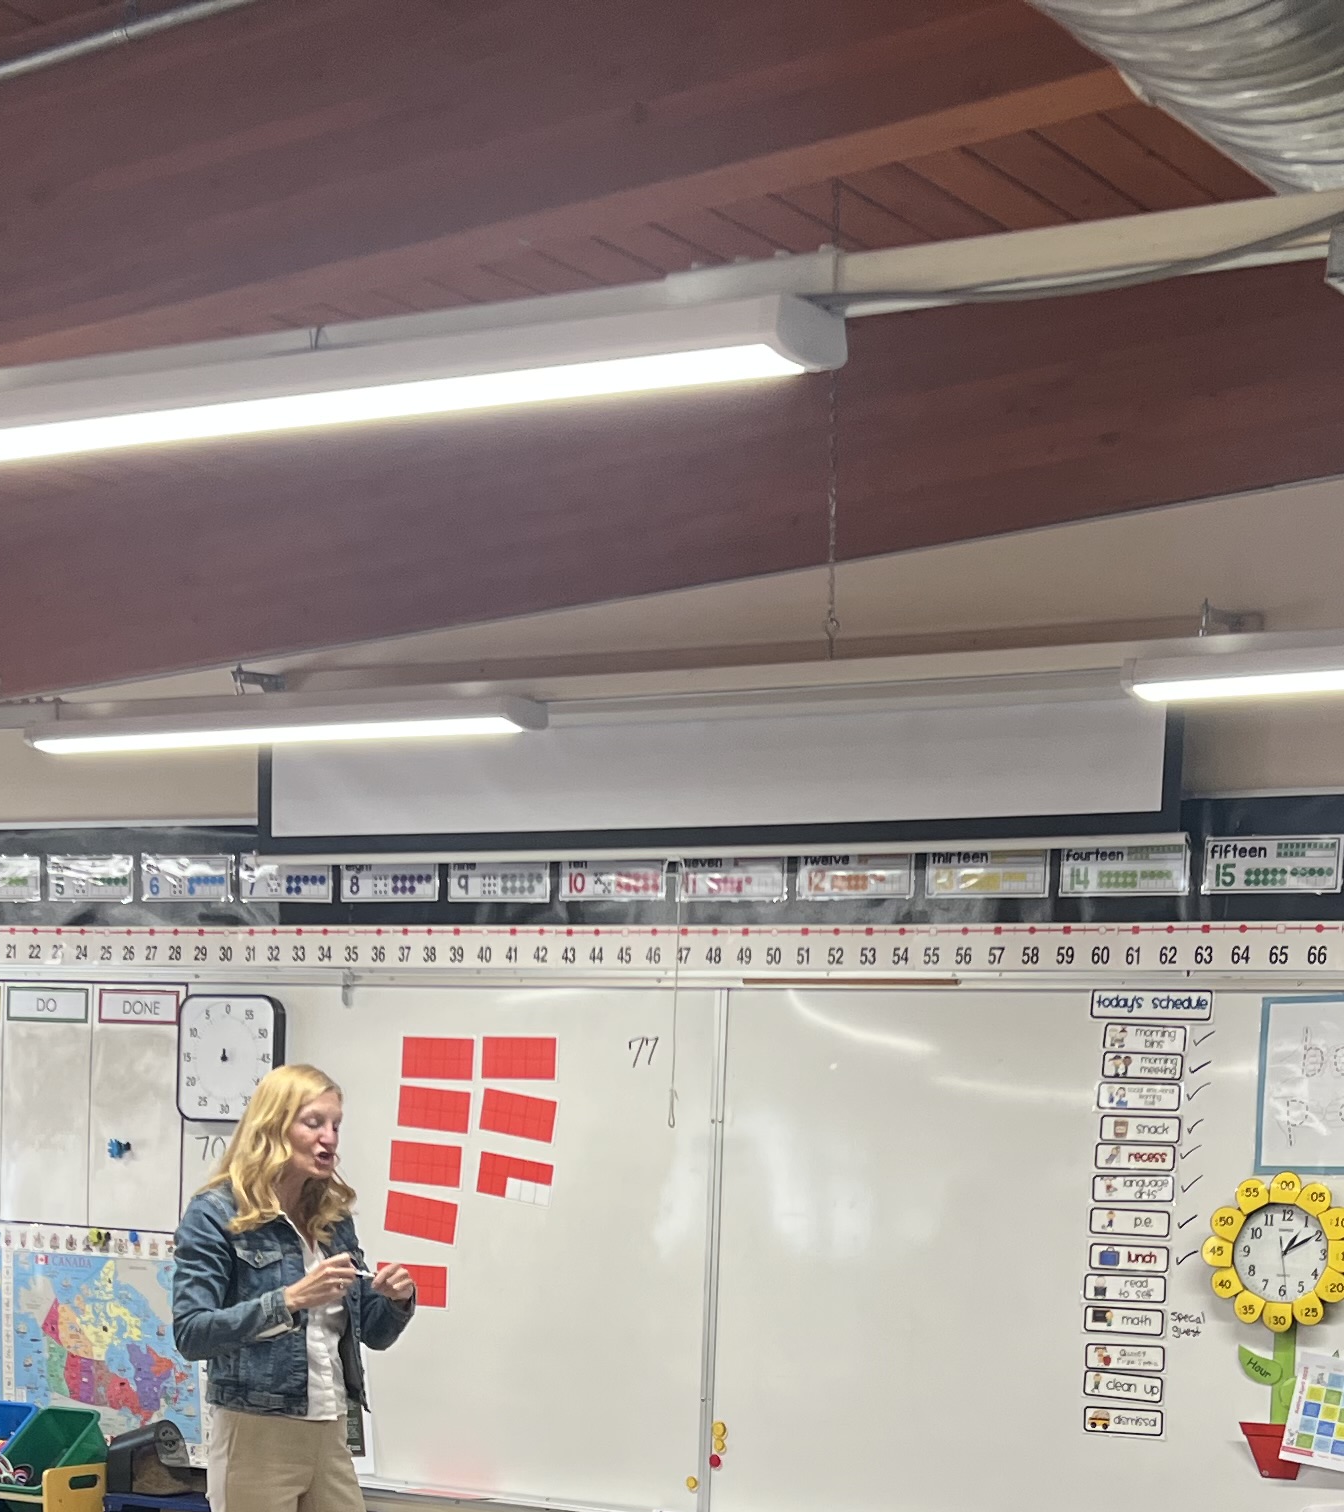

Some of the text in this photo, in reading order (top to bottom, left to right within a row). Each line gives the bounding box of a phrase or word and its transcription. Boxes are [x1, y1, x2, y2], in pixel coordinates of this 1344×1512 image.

[1065, 848, 1125, 862] fourteen
[1210, 843, 1267, 860] fifteen
[568, 872, 586, 893] 10
[1069, 866, 1089, 890] 14
[1214, 864, 1236, 887] 15
[36, 998, 57, 1013] DO
[122, 1000, 161, 1016] DONE
[1096, 993, 1208, 1014] today's schedule
[1135, 1027, 1177, 1042] morning
[628, 1036, 659, 1069] 77
[1140, 1055, 1178, 1068] morning
[1139, 1064, 1177, 1078] meeting
[1136, 1122, 1169, 1135] snack
[1127, 1151, 1168, 1163] recess
[1122, 1176, 1169, 1190] language
[1134, 1188, 1157, 1200] arts
[1282, 1209, 1294, 1221] 12
[1250, 1227, 1262, 1239] 10
[50, 1256, 92, 1269] CANADA
[1127, 1250, 1157, 1265] lunch
[1311, 1268, 1319, 1280] 4
[1123, 1278, 1149, 1288] read
[1118, 1287, 1155, 1299] to self
[1278, 1285, 1286, 1297] 6
[1121, 1315, 1152, 1327] math
[1246, 1357, 1273, 1379] Hour
[1105, 1378, 1160, 1397] clean up
